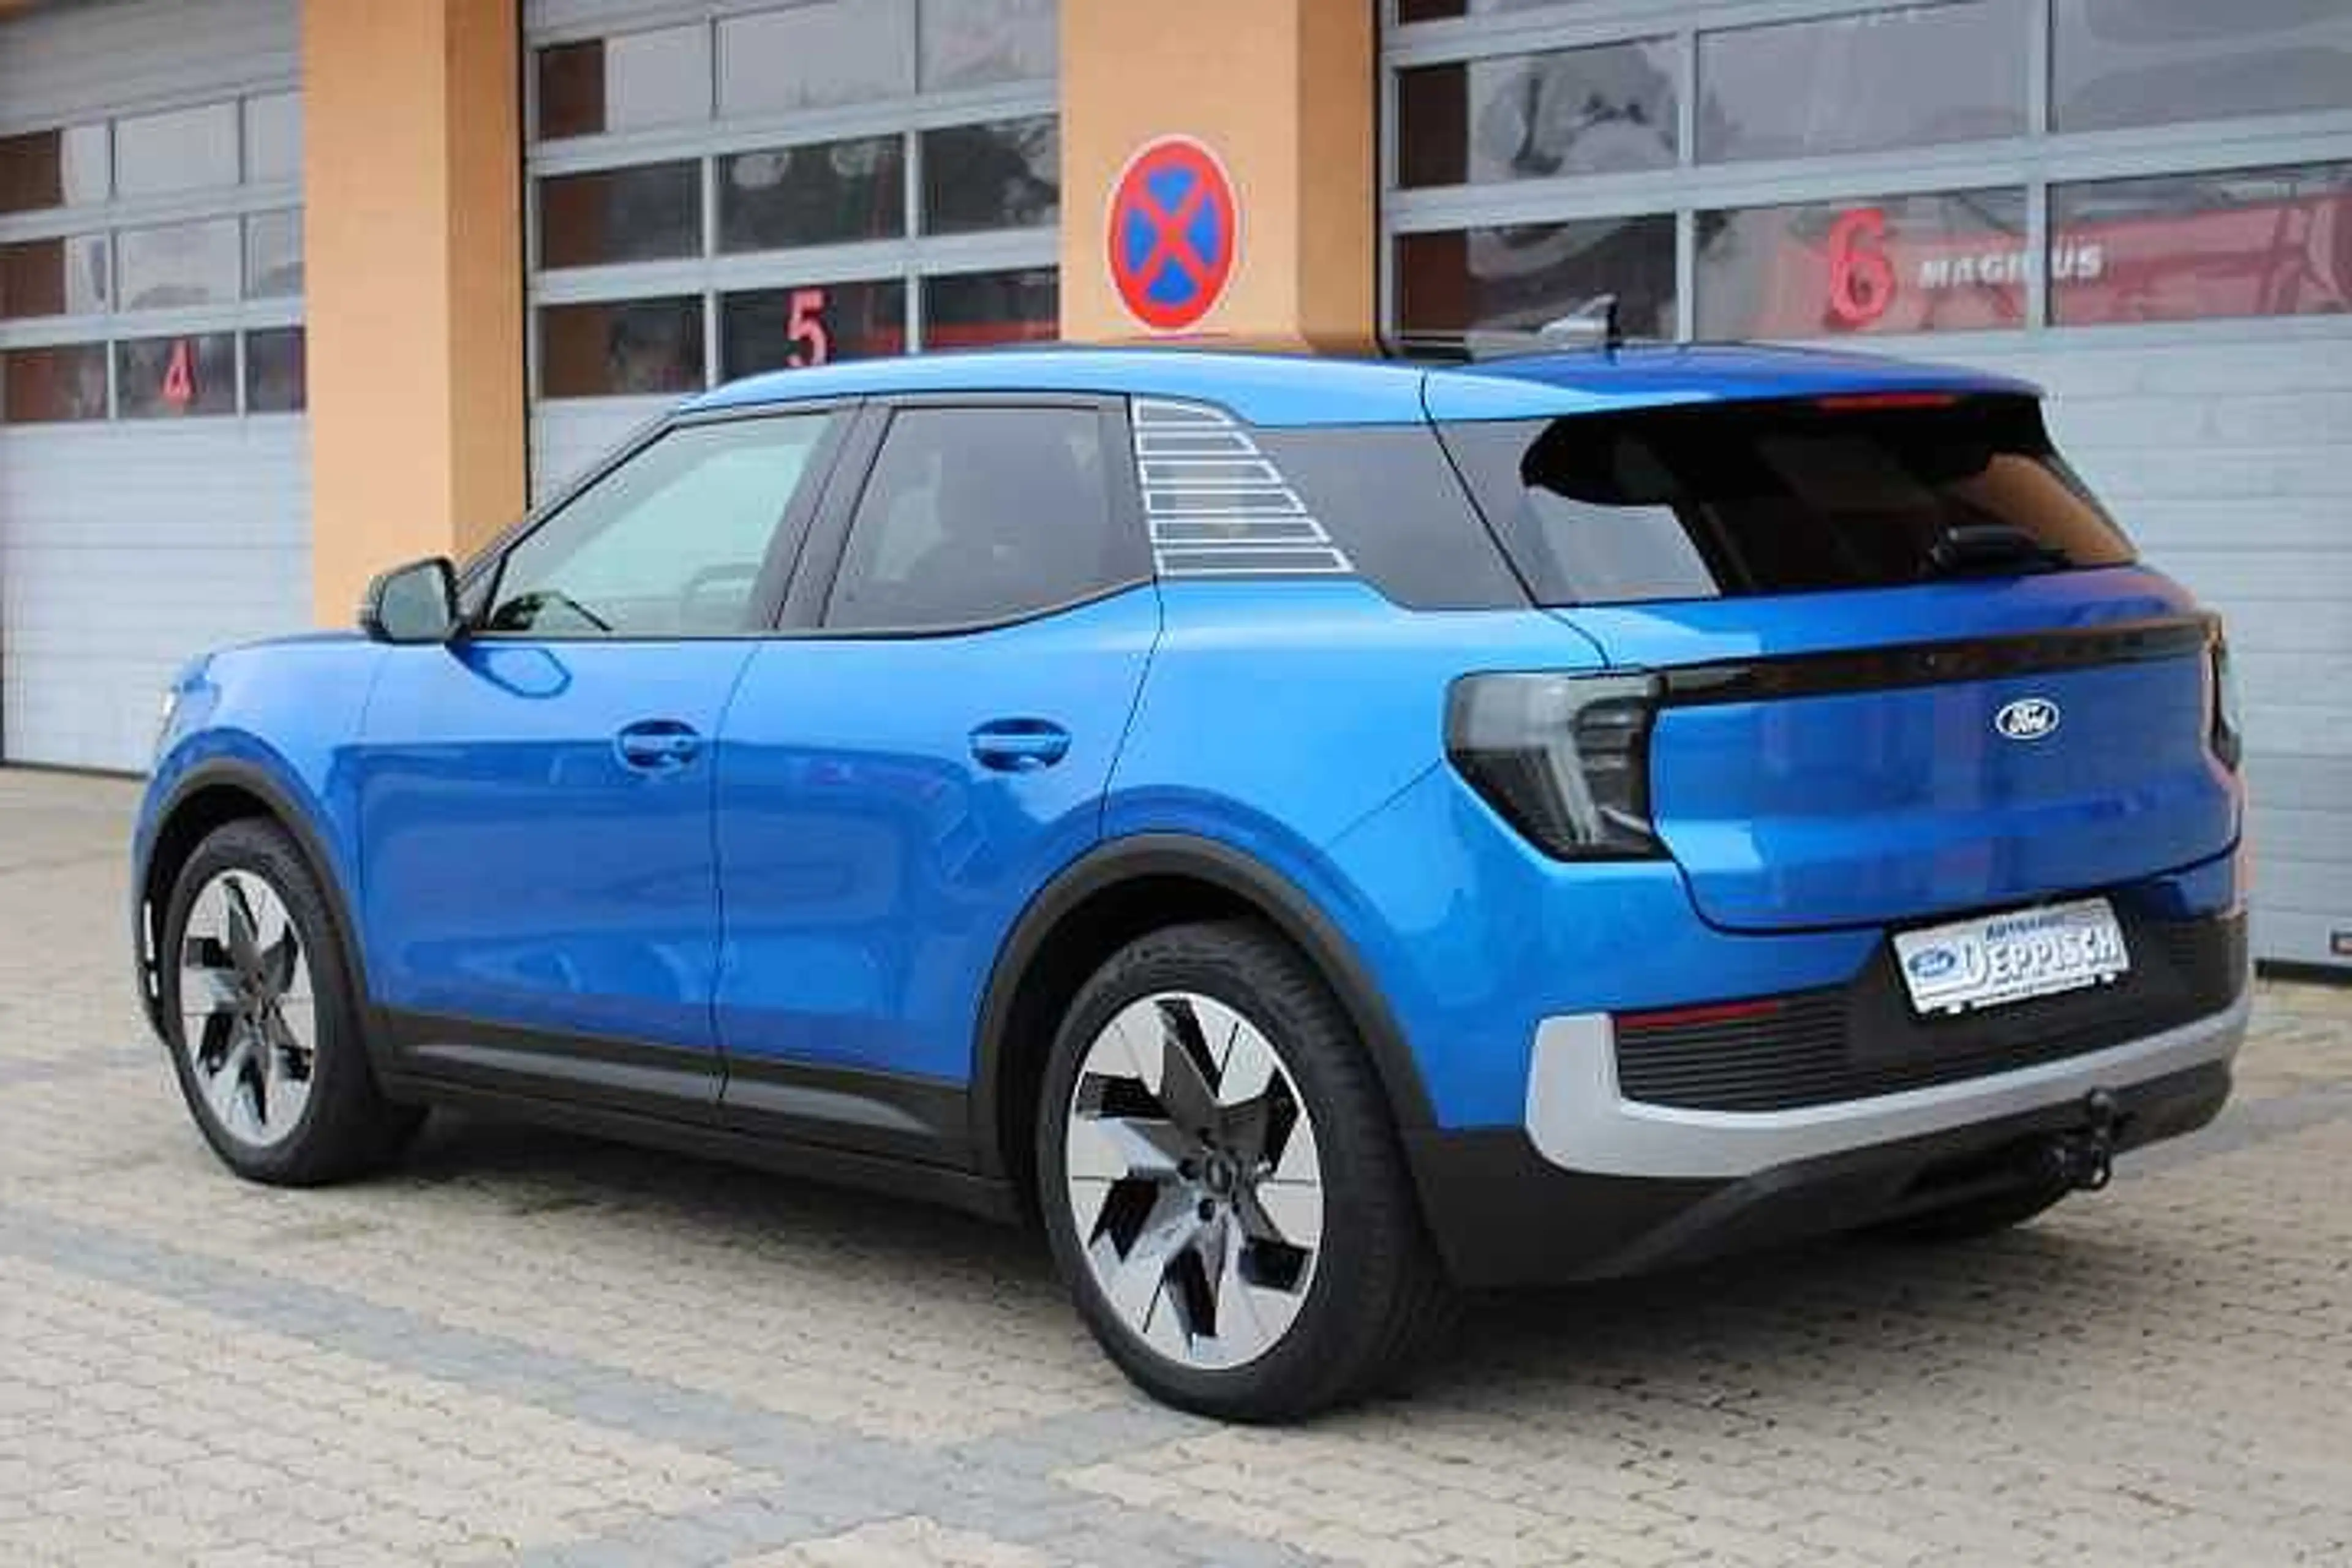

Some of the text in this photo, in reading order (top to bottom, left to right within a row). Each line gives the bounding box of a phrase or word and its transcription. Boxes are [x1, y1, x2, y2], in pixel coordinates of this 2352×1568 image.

[1828, 206, 1896, 327] 6
[1918, 244, 2101, 289] MAGIUS
[786, 286, 832, 367] 5
[162, 336, 197, 405] 4
